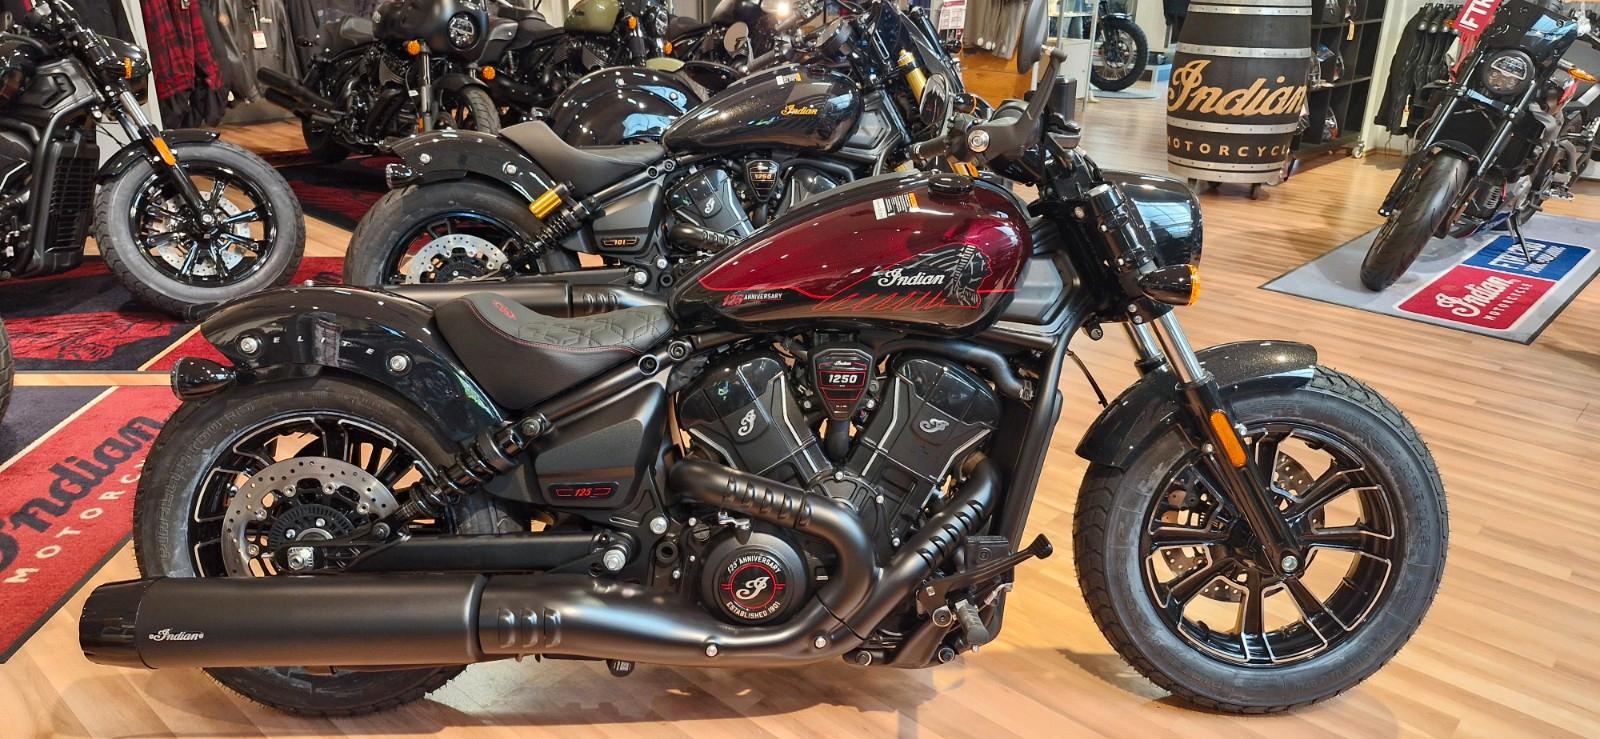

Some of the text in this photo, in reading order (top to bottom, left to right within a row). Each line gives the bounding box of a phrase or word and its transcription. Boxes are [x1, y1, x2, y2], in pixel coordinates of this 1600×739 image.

[1168, 59, 1307, 116] Indian
[781, 104, 818, 115] Indian
[878, 267, 945, 287] Indian
[744, 292, 783, 301] ANNIVERSARY
[1435, 276, 1521, 318] Indian
[1482, 283, 1533, 321] MOTORCYCLE
[273, 335, 375, 355] ELITE
[829, 374, 858, 384] 1250
[574, 488, 593, 497] 125
[739, 555, 782, 574] ANNIVERSARY
[726, 600, 781, 619] ESTABLISHED 1901
[152, 628, 199, 642] Indian
